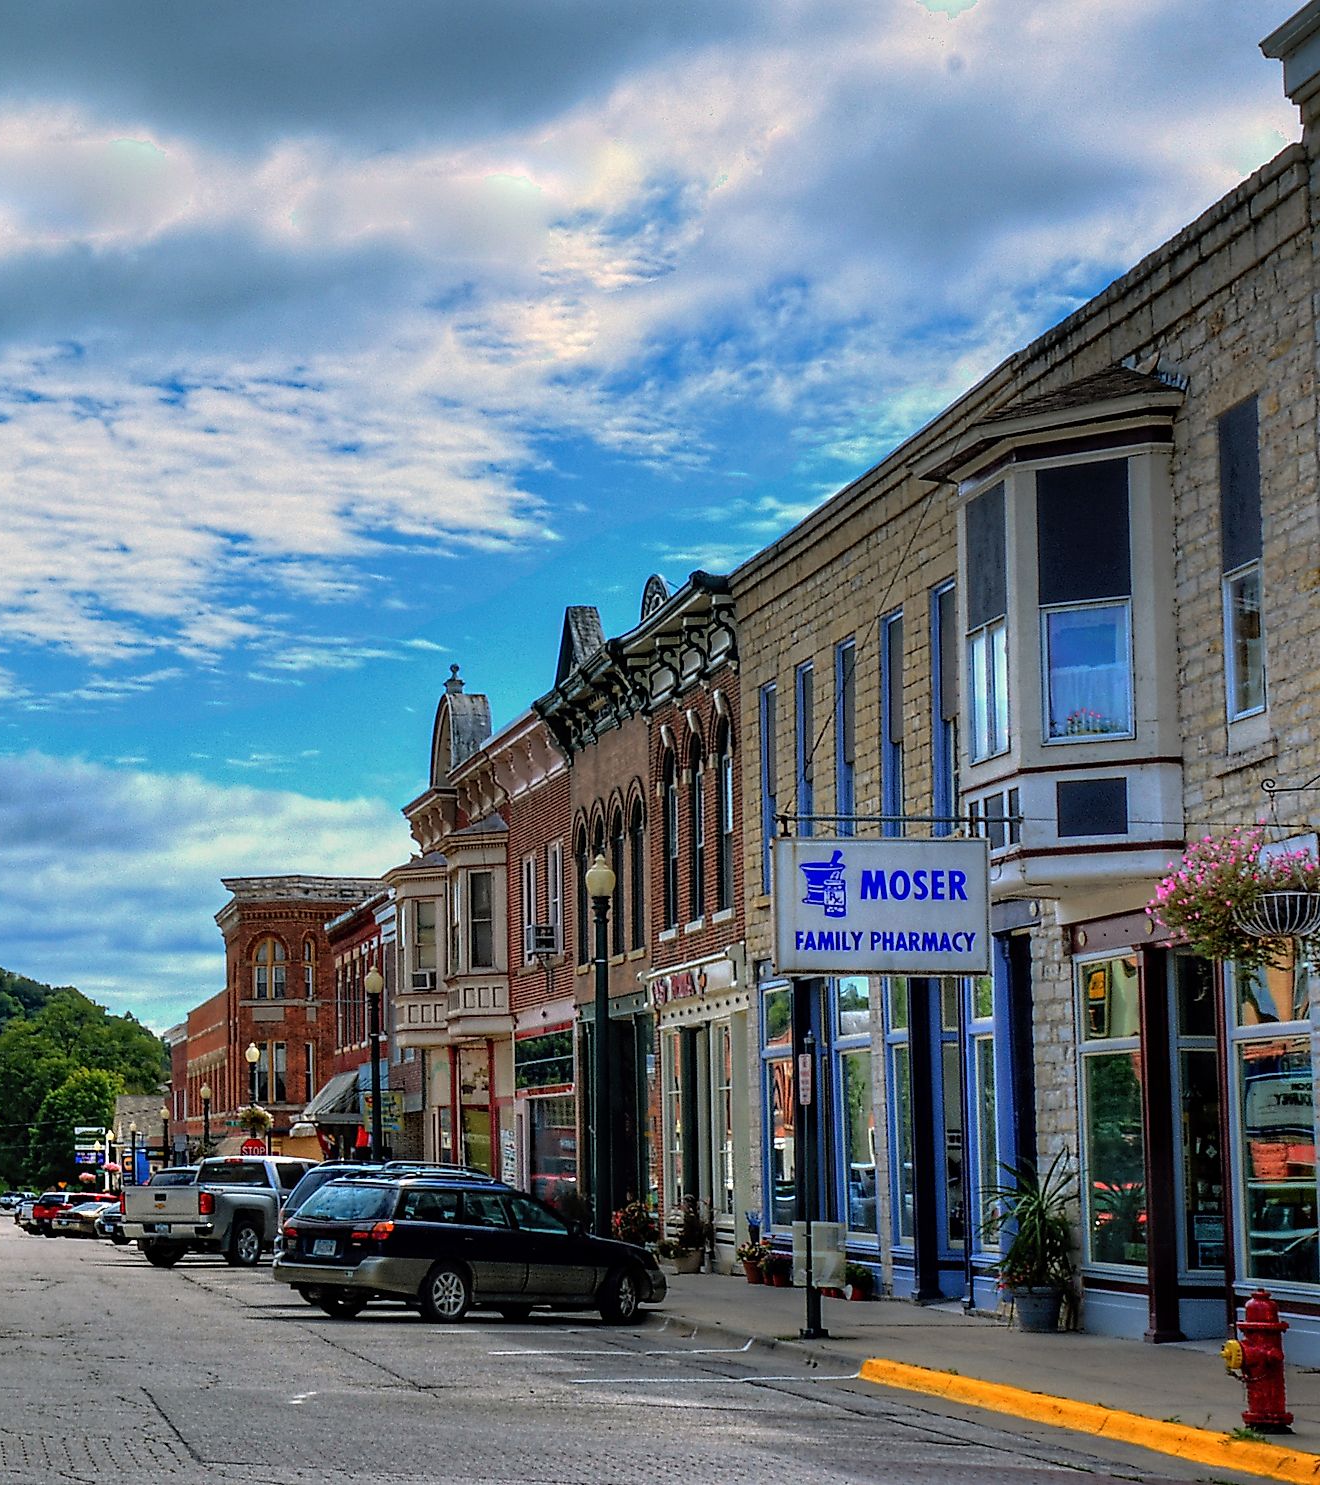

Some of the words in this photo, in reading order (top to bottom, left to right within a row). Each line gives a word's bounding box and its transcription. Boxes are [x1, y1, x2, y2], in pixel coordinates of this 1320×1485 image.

[860, 870, 968, 900] MOSER
[795, 931, 863, 951] FAMILY
[870, 932, 976, 952] PHARMACY
[242, 1146, 266, 1156] STOP
